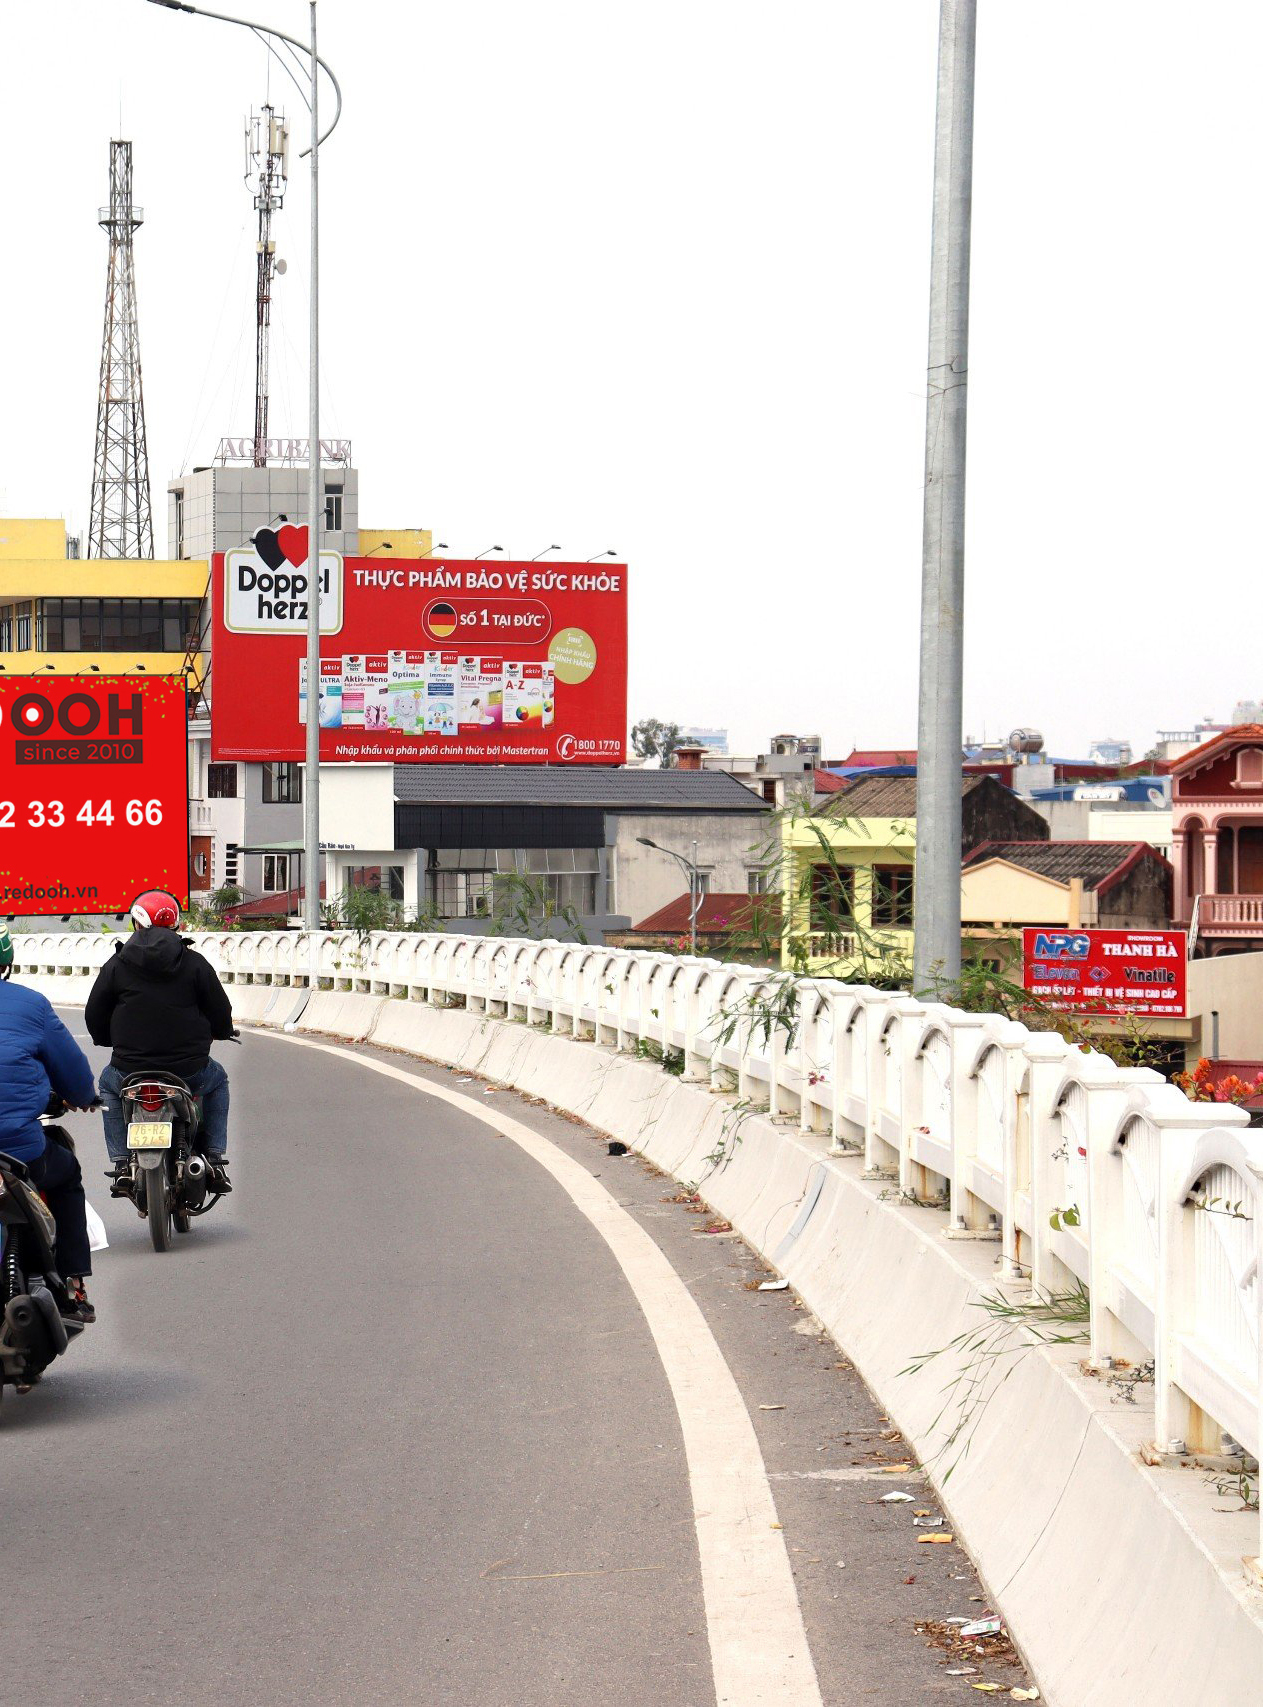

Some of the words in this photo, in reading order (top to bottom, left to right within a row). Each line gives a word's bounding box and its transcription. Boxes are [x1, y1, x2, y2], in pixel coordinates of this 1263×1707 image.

[239, 566, 329, 599] Doppl
[353, 569, 405, 590] THỰC
[408, 566, 461, 588] PHẨM
[466, 568, 503, 589] BẢO
[506, 569, 528, 592] VỆ
[532, 570, 567, 590] SỨC
[572, 571, 620, 592] KHỎE
[258, 594, 308, 619] herz
[460, 611, 477, 626] SỐ
[480, 609, 489, 626] 1
[492, 614, 511, 628] TẠI
[344, 675, 388, 683] Aktiv-Meno
[393, 671, 419, 679] Optima
[478, 675, 502, 683] Pregna
[505, 680, 525, 690] A-Z
[11, 692, 143, 736] OOH
[24, 744, 80, 760] since
[87, 743, 135, 760] 2010
[335, 745, 359, 756] Nhập
[361, 744, 382, 755] khẩu
[384, 746, 394, 755] và
[396, 745, 417, 756] phân
[419, 745, 438, 756] phối
[440, 745, 463, 755] chính
[465, 745, 484, 755] thức
[486, 745, 500, 755] bởi
[502, 746, 549, 755] Mastertran
[574, 740, 596, 750] 1800
[599, 740, 621, 750] 1770
[27, 800, 65, 827] 33
[76, 799, 115, 827] 44
[126, 799, 163, 826] 66
[1034, 934, 1090, 957] NPG
[1102, 943, 1153, 956] THANH
[1156, 941, 1178, 957] HÀ
[1123, 967, 1175, 983] Vinatile
[1125, 988, 1144, 998] SINH
[1145, 988, 1160, 998] CAO
[1161, 987, 1177, 999] CẤP
